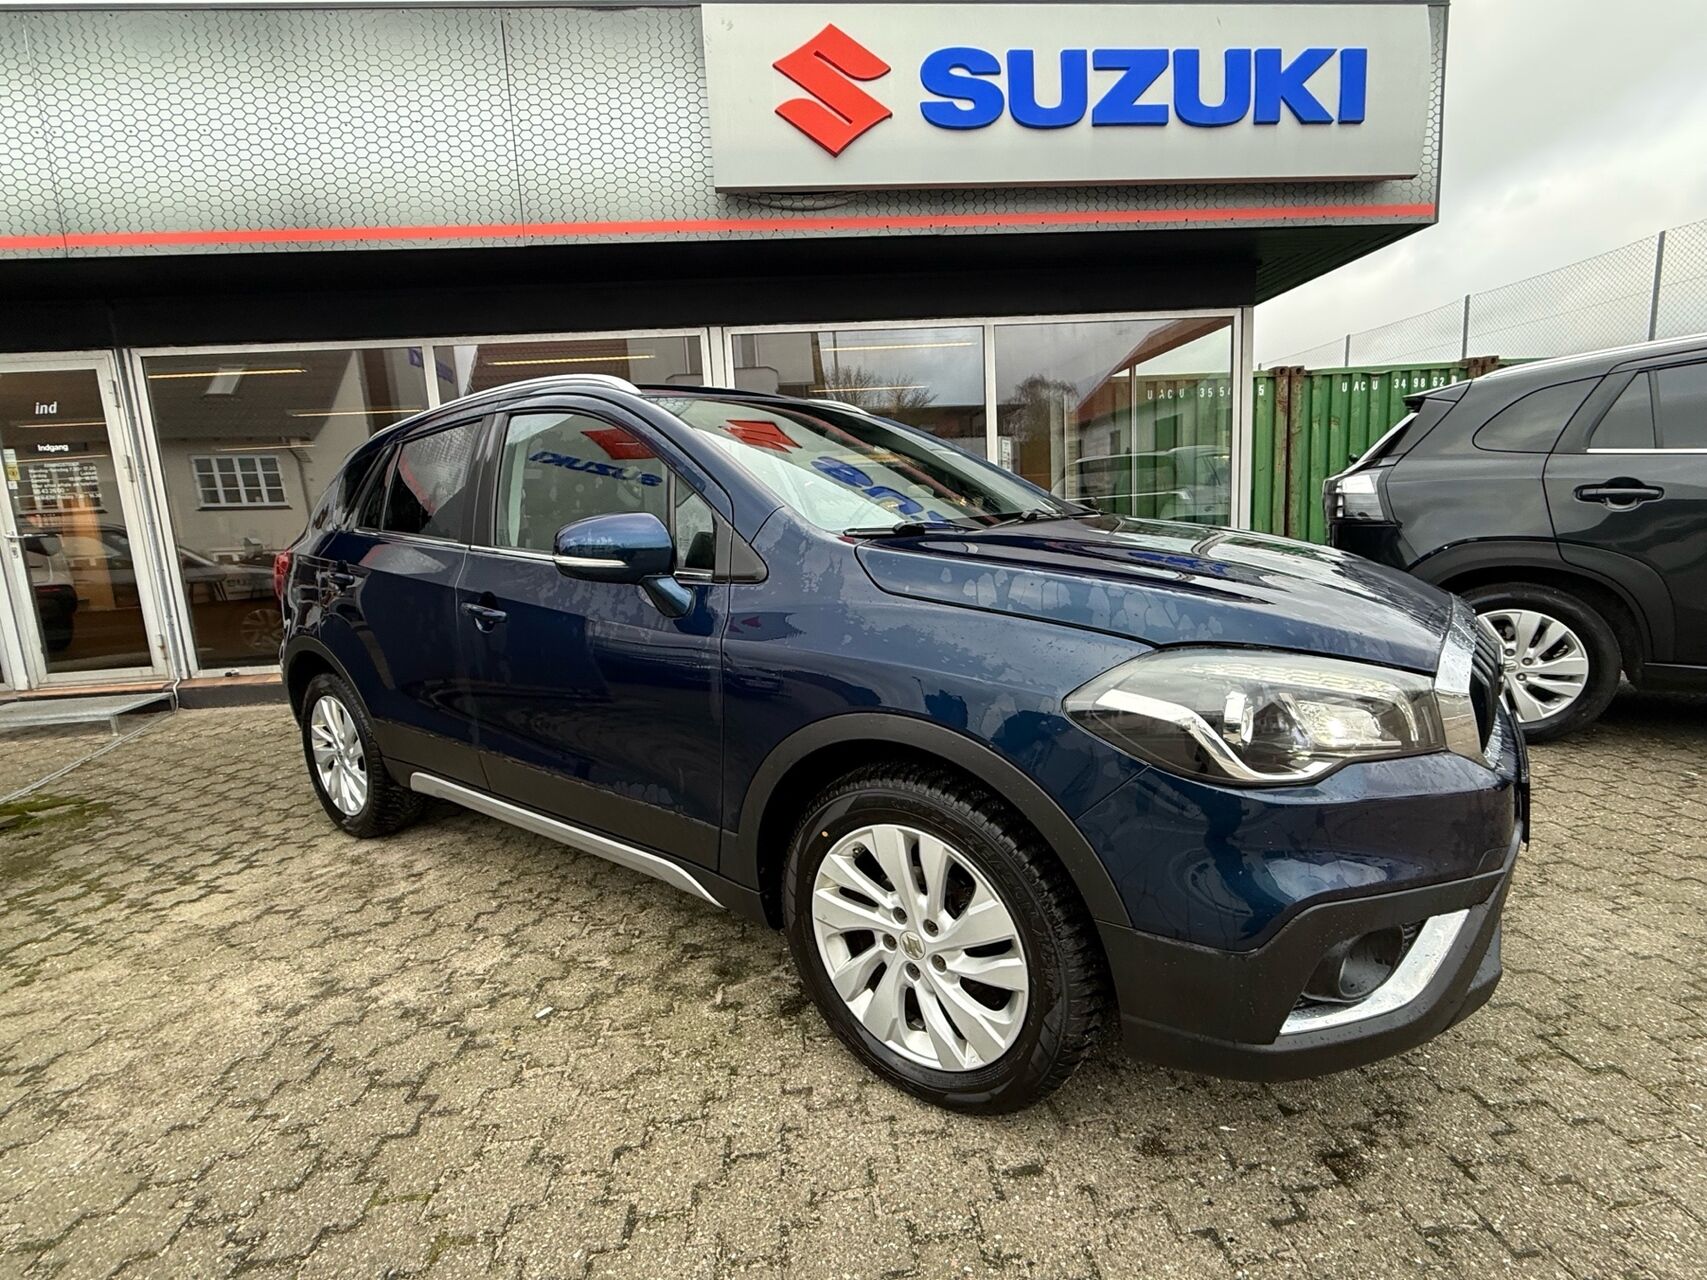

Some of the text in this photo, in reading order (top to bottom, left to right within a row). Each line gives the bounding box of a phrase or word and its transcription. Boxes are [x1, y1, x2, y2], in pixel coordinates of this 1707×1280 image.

[920, 46, 1368, 130] SUZUKI
[35, 401, 57, 415] ind
[37, 444, 69, 452] Indgang
